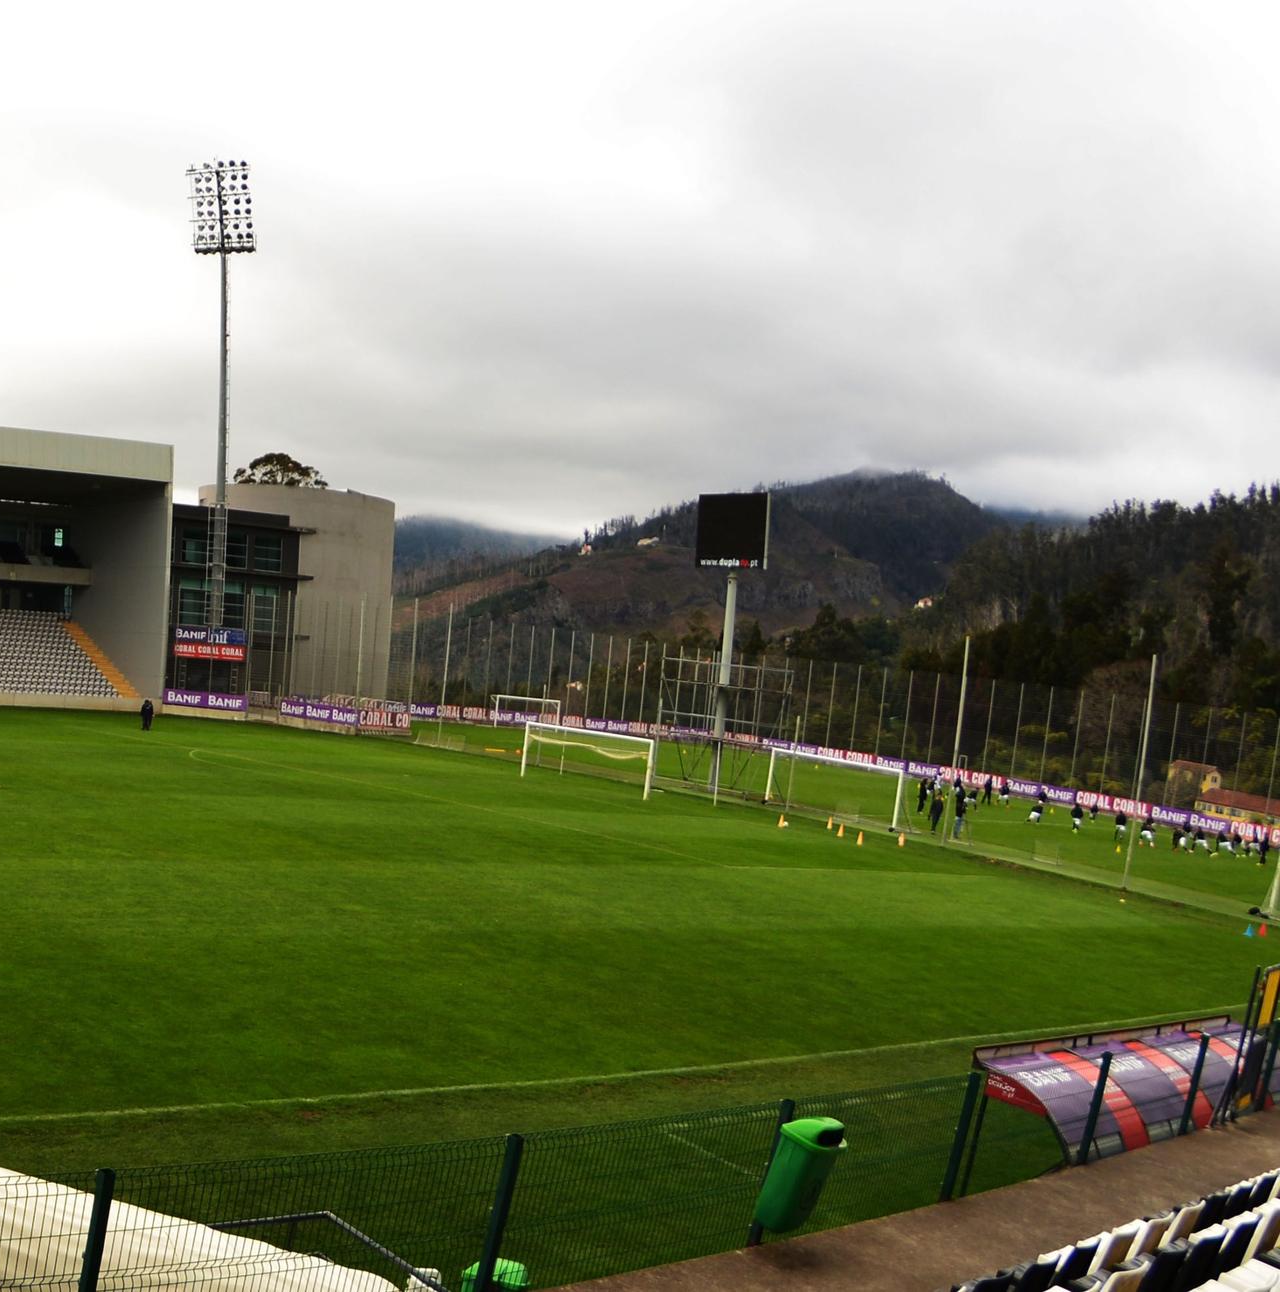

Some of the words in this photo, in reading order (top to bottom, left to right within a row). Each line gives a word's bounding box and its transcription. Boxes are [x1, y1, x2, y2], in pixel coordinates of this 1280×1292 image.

[221, 647, 244, 656] CORAL
[167, 691, 201, 704] BANIF
[208, 695, 243, 708] BANIF
[281, 702, 304, 714] BANIF
[306, 705, 330, 719] BANIF
[359, 711, 393, 726] CORAL
[410, 704, 435, 716] BANIF
[463, 707, 486, 720] CORAL
[562, 715, 584, 728] CORAL
[586, 719, 606, 729] BANIF
[607, 721, 628, 731] BANIF
[817, 746, 844, 760] CORAL
[846, 751, 874, 765] CORAL
[876, 758, 905, 771] BANIF
[908, 762, 937, 776] BANIF
[1076, 790, 1111, 809] CORAL
[1151, 806, 1188, 823] BANIF
[1190, 814, 1227, 831] BANIF
